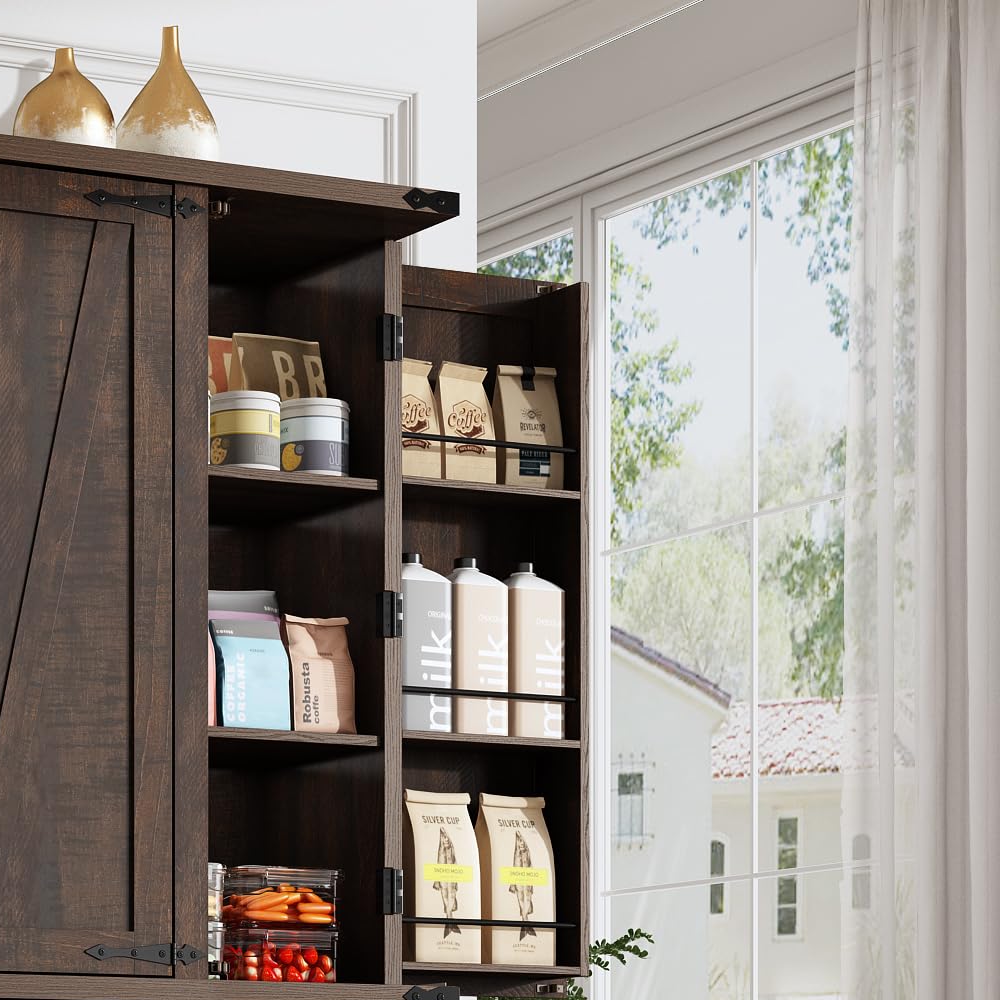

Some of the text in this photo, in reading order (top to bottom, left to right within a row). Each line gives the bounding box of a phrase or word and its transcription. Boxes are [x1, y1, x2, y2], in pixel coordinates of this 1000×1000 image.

[448, 407, 486, 430] Coffee
[520, 422, 545, 433] REVELATOR
[226, 662, 236, 722] COFFEE
[236, 652, 246, 722] ORGANIC
[302, 662, 312, 723] Robusta
[421, 630, 452, 732] milk
[422, 815, 460, 825] SILVER CUP
[497, 819, 536, 829] SILVER CUP
